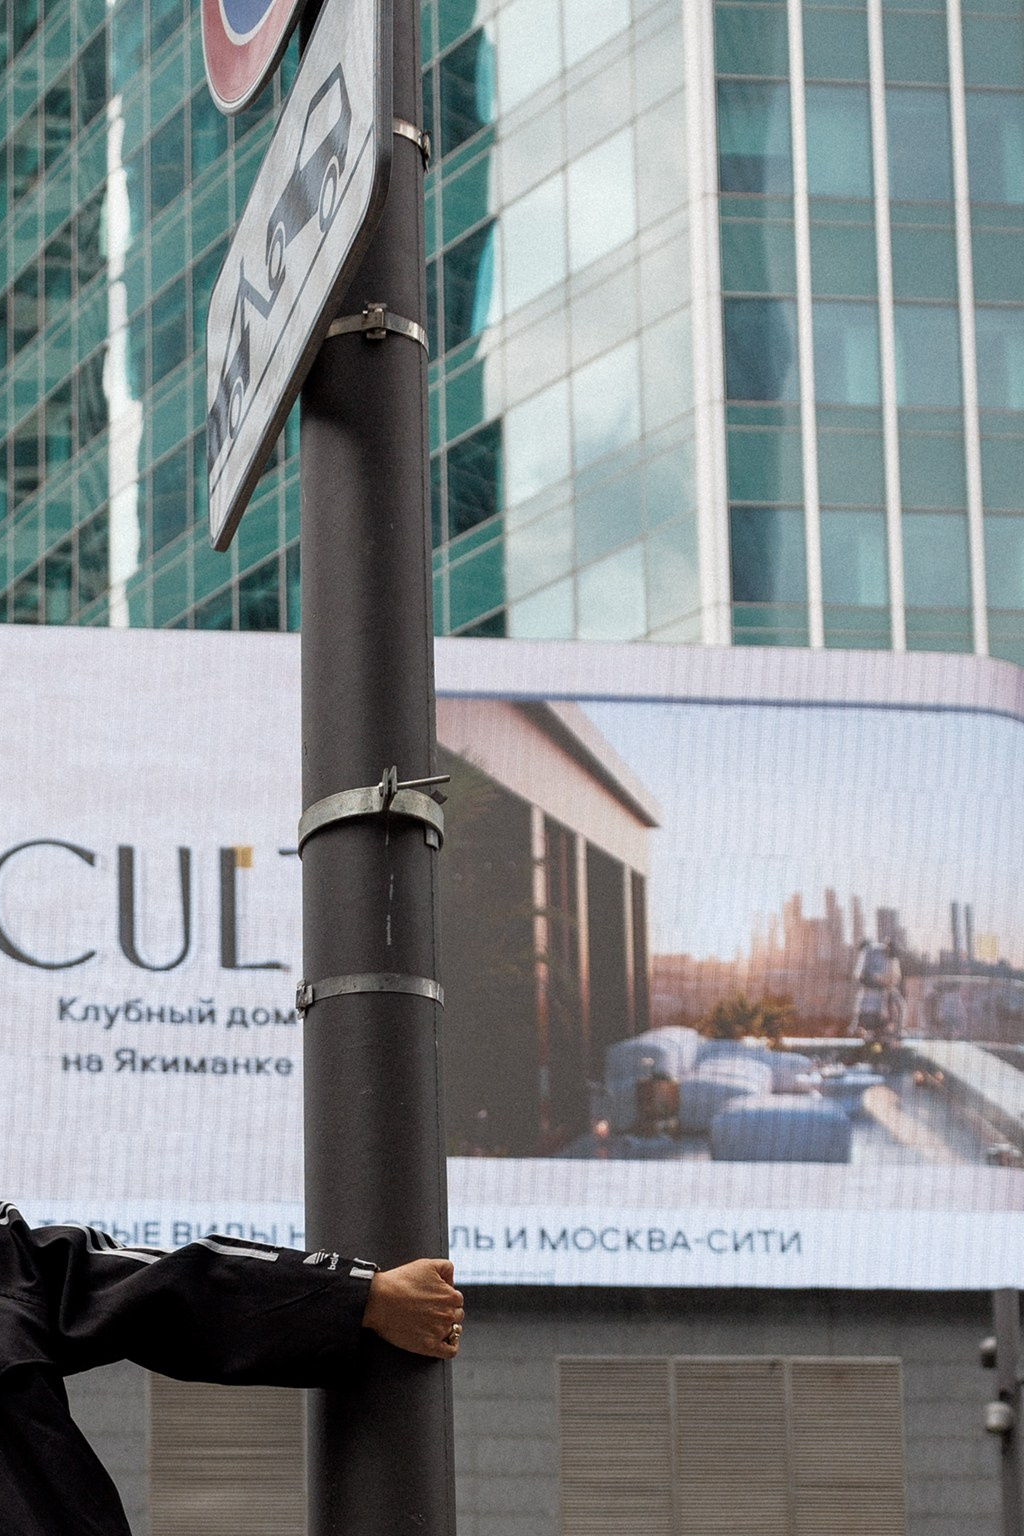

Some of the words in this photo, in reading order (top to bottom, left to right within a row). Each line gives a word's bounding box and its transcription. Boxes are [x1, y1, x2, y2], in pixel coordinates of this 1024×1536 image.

[58, 996, 217, 1030] Клубный
[227, 1006, 298, 1029] дом
[61, 1053, 104, 1073] на
[114, 1048, 294, 1075] Якиманке
[504, 1226, 527, 1250] И
[540, 1227, 802, 1254] МОСКВА-СИТИ
